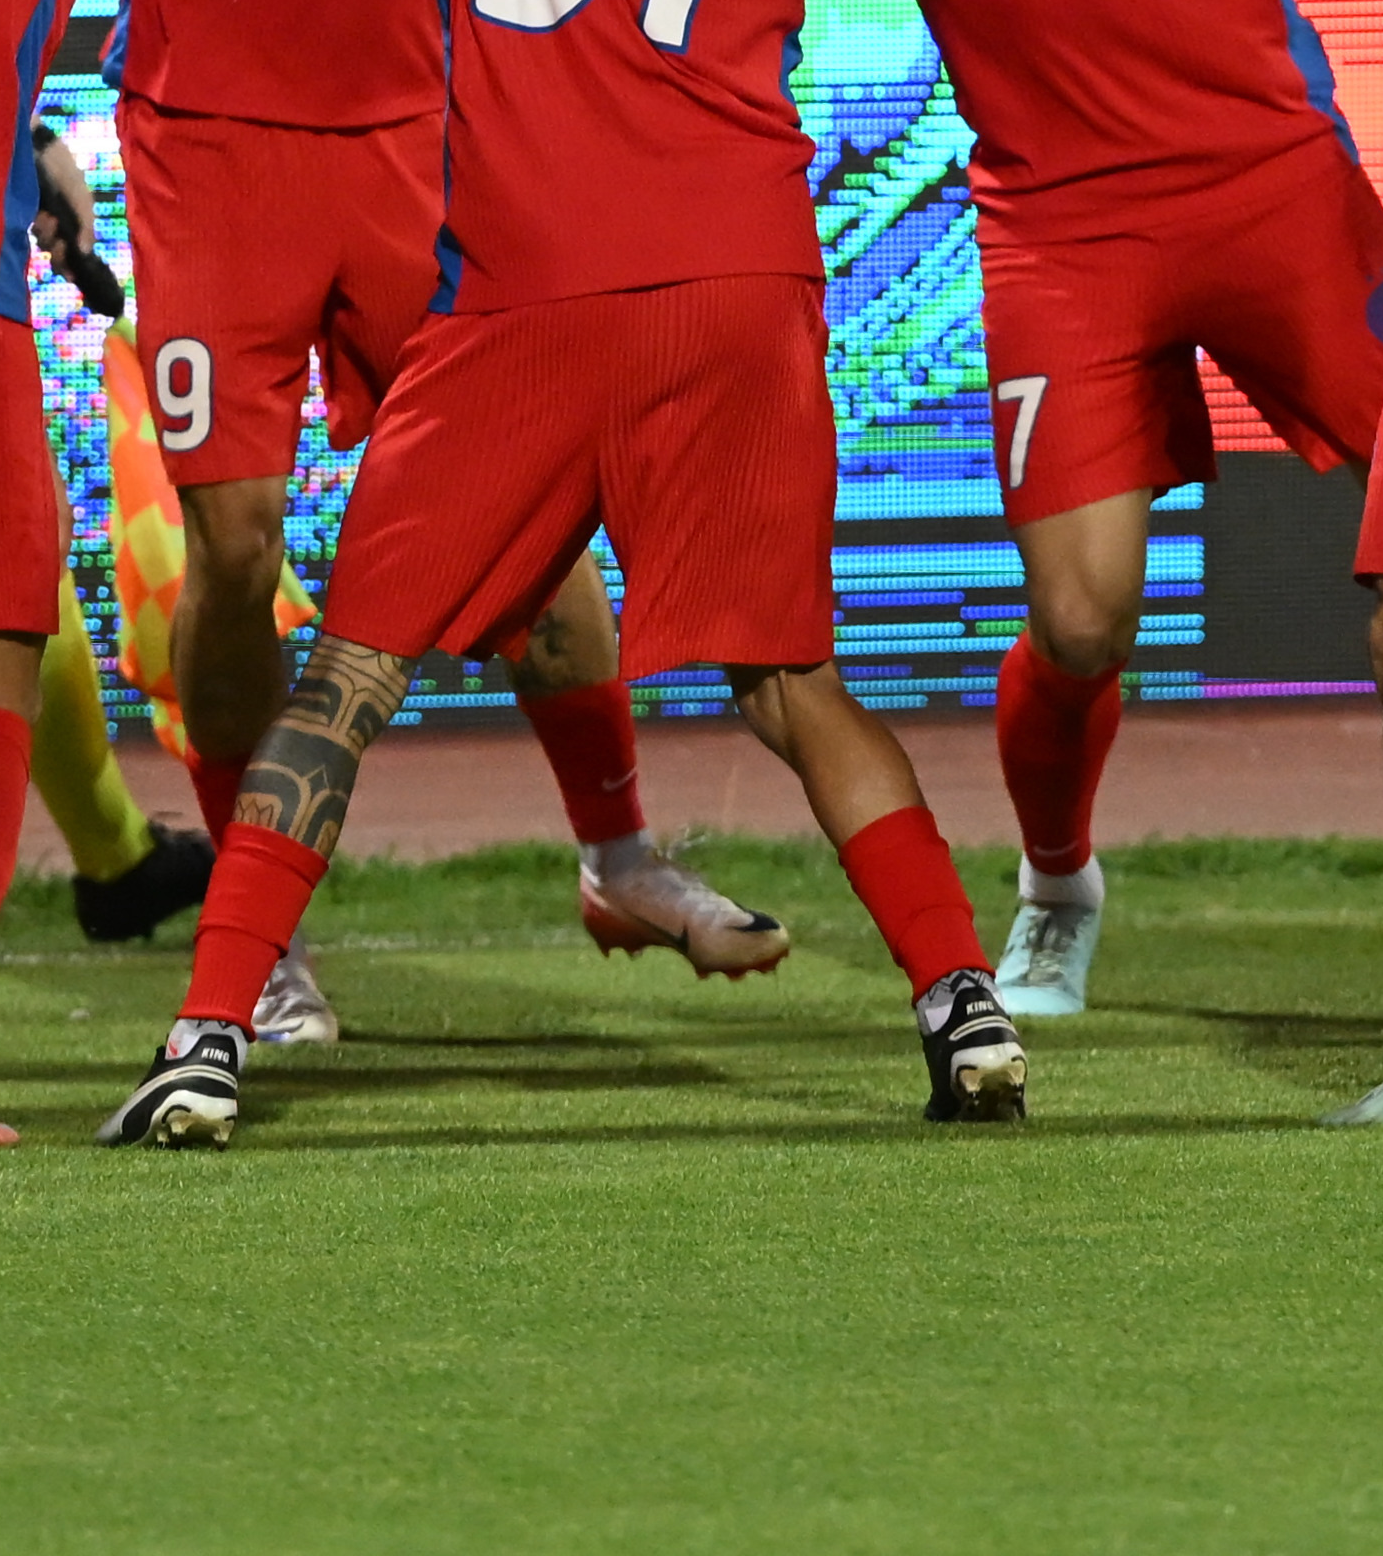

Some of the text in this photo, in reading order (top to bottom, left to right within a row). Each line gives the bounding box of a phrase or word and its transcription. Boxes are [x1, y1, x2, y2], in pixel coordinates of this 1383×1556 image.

[155, 337, 214, 452] 9
[997, 374, 1049, 490] 7
[966, 1000, 995, 1015] KING
[201, 1047, 230, 1064] KING
